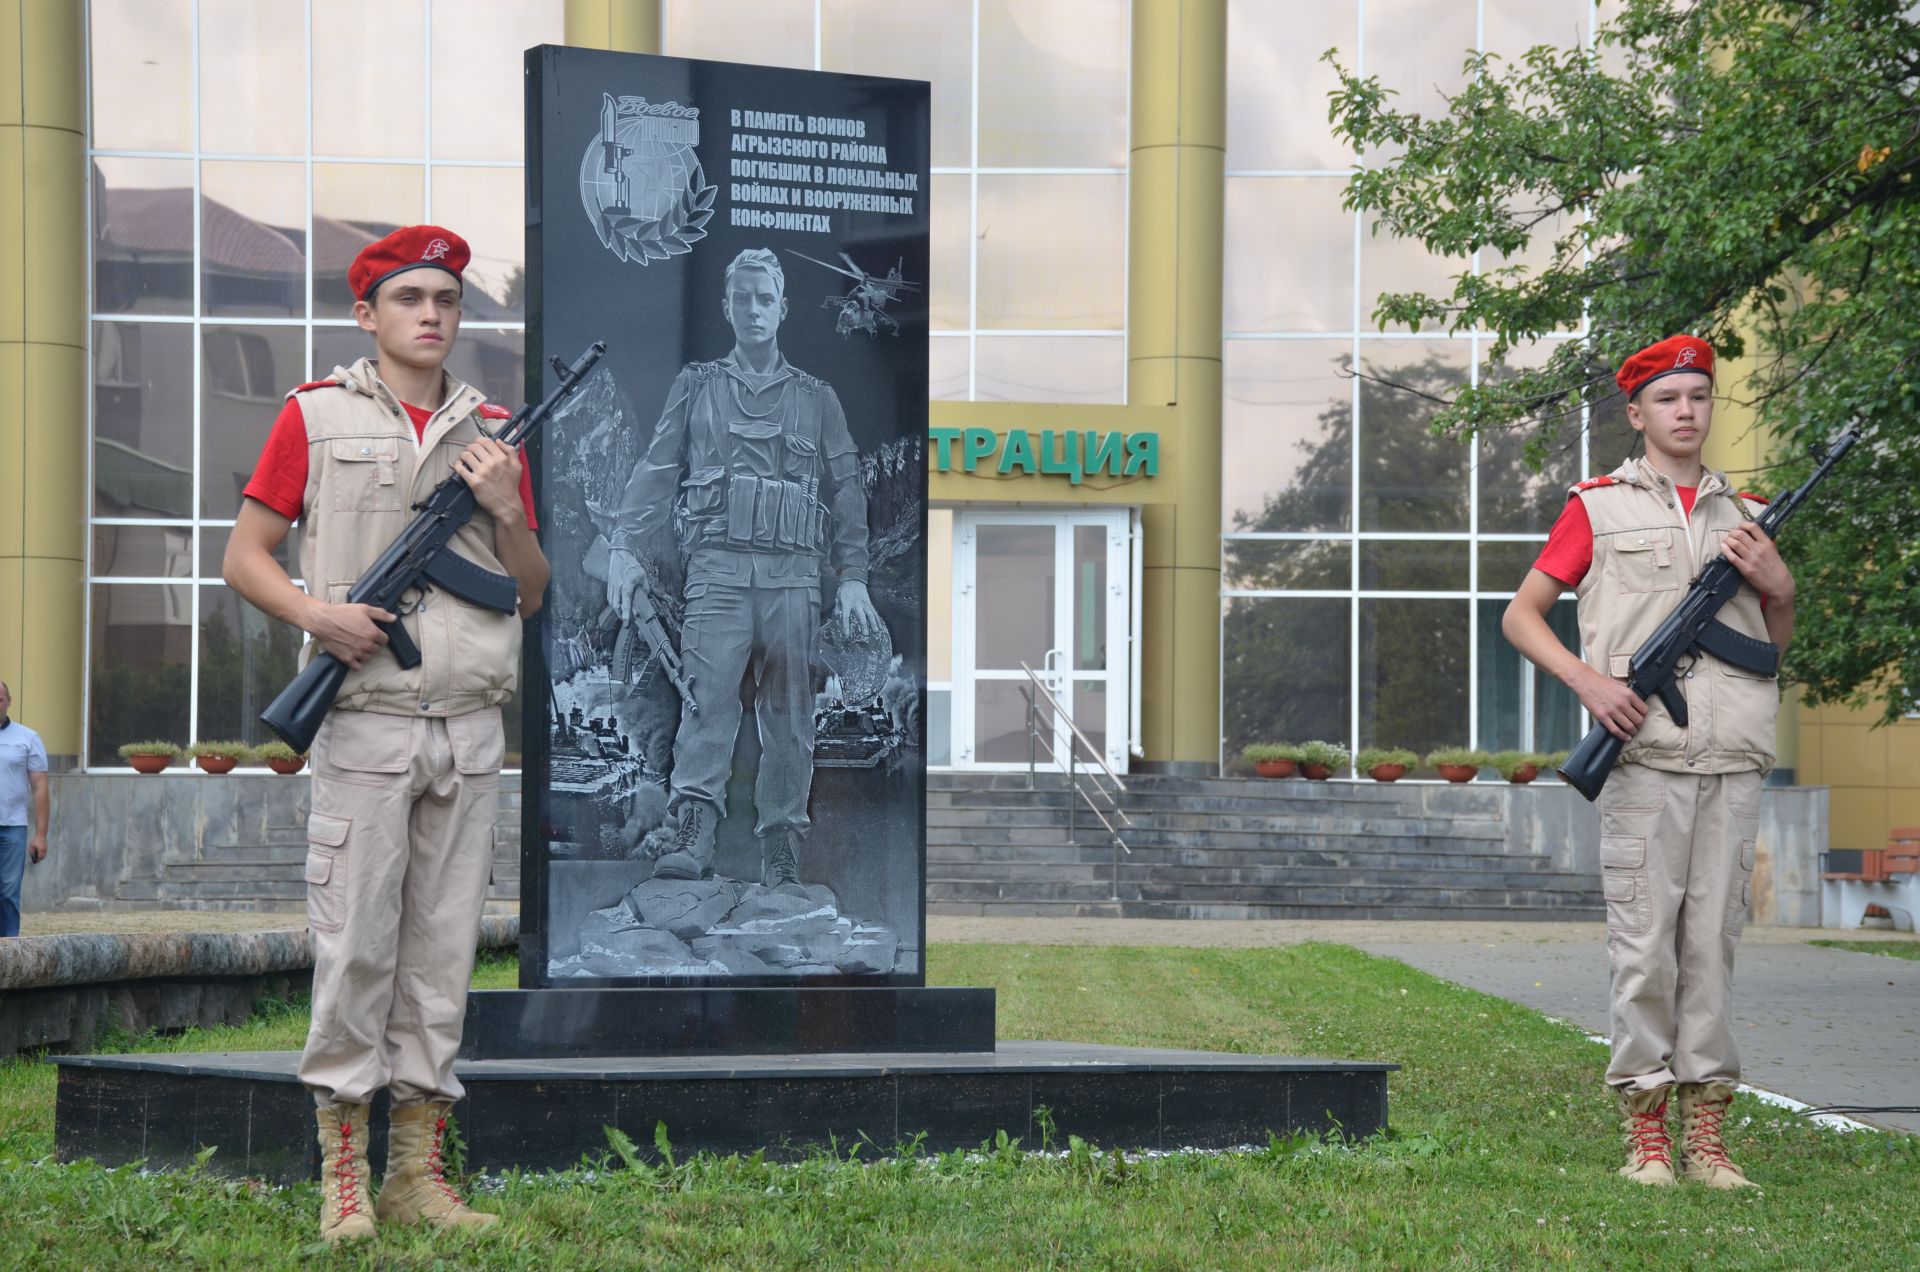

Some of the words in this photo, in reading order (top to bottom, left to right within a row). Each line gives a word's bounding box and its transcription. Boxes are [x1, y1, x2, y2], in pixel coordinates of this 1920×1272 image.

[731, 108, 741, 127] В
[744, 109, 804, 133] ПАМЯТЬ
[807, 115, 866, 138] ВОИНОВ
[731, 133, 829, 159] АГРЫЗСКОГО
[831, 140, 888, 164] РАЙОНА
[731, 158, 812, 183] ПОГИБШИХ
[814, 166, 824, 184] В
[826, 166, 918, 191] ЛОКАЛЬНЫХ
[731, 181, 789, 205] ВОЙНАХ
[791, 188, 801, 206] И
[804, 189, 914, 215] ВООРУЖЕННЫХ
[731, 207, 831, 233] КОНФЛИКТАХ
